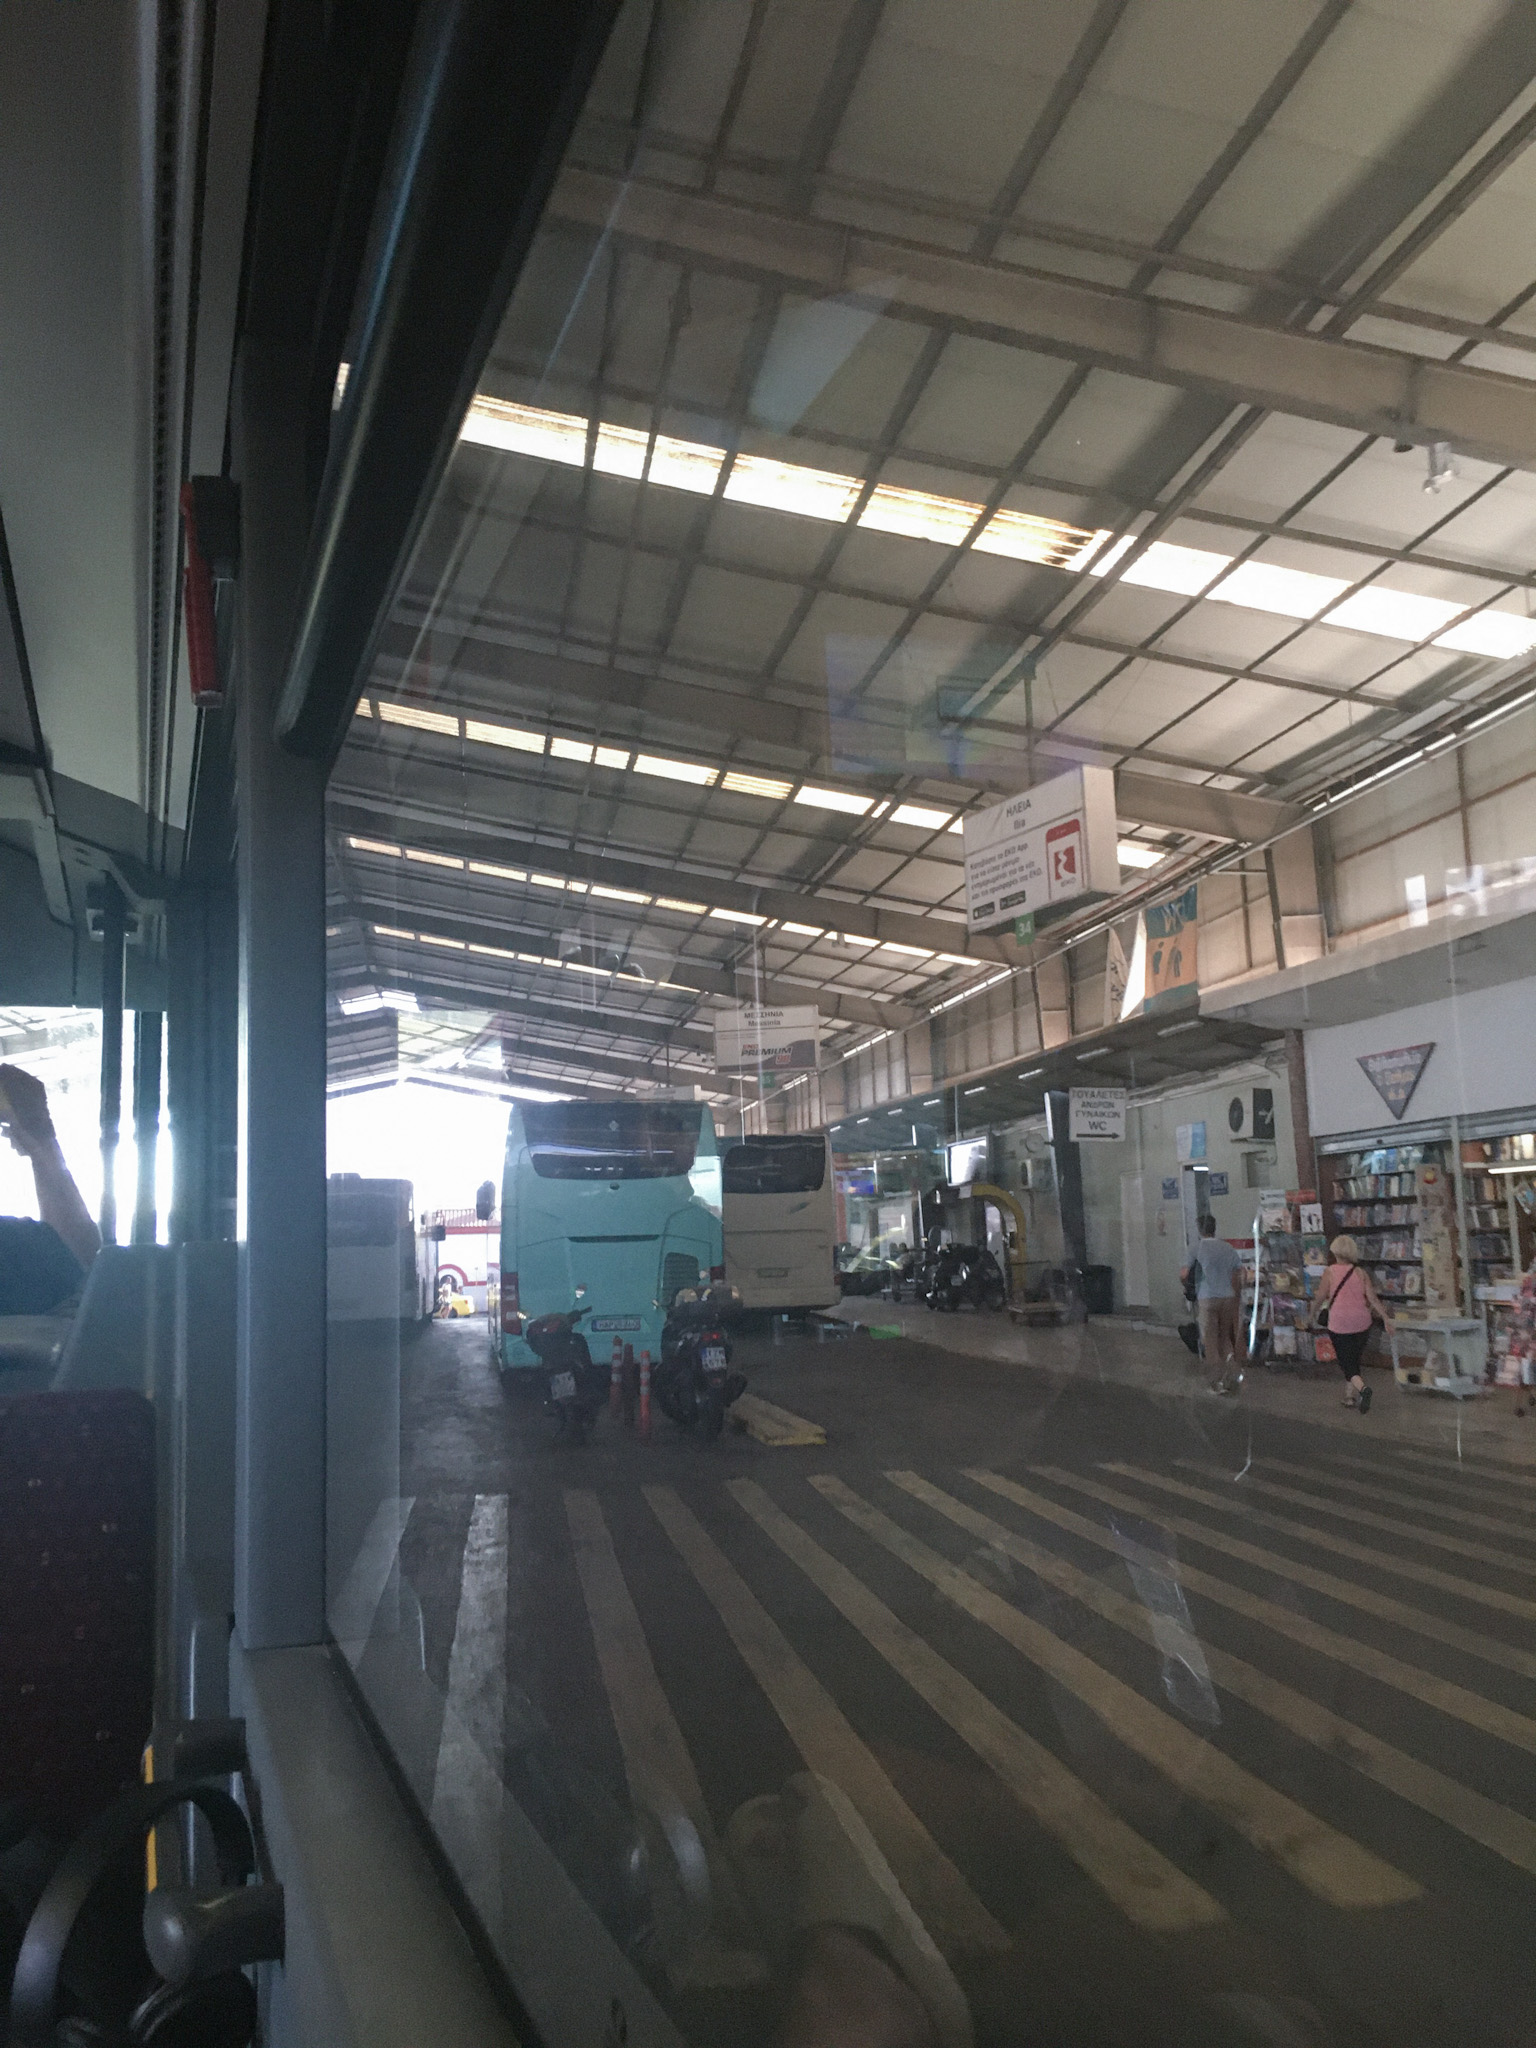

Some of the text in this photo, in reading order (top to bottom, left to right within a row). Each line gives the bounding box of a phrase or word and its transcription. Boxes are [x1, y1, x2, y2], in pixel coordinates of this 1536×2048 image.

[1006, 798, 1032, 818] ΗΛΕΙΑ
[1018, 920, 1032, 937] 34
[742, 1047, 792, 1056] PREMIUM
[1088, 1120, 1107, 1130] WC
